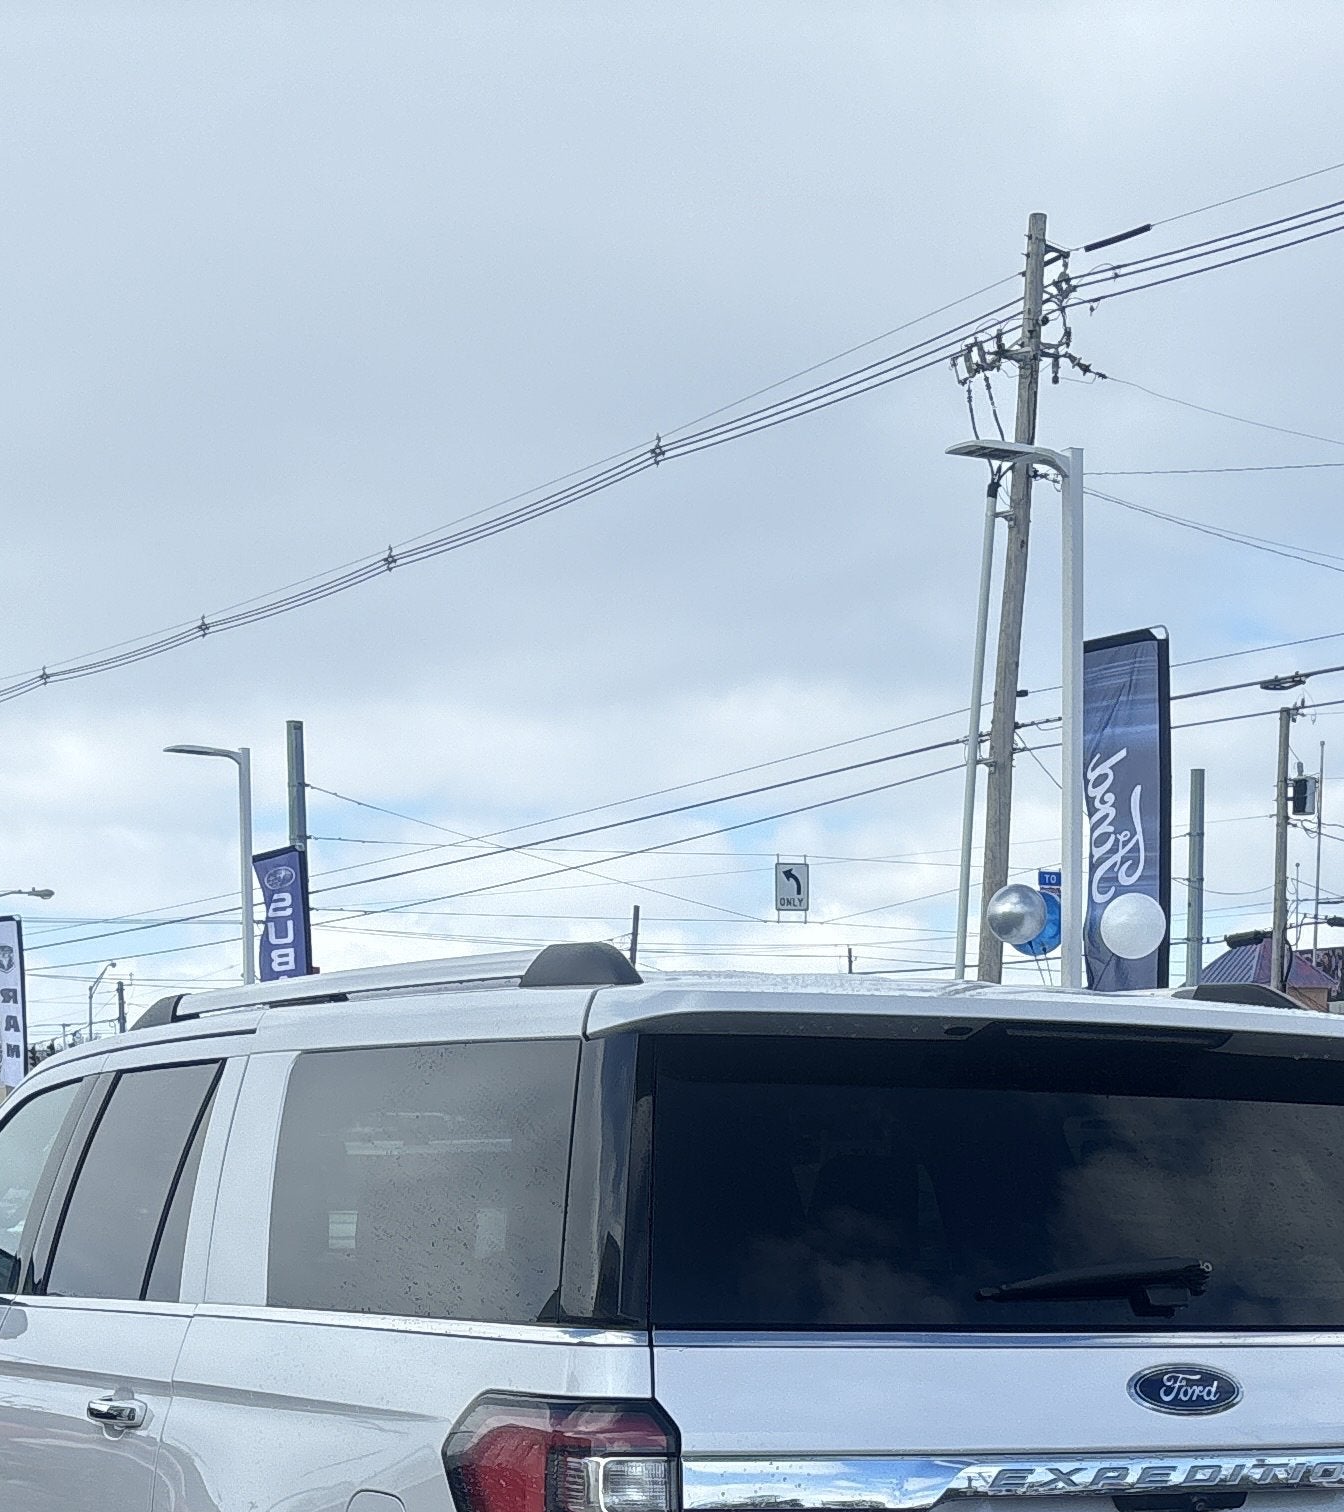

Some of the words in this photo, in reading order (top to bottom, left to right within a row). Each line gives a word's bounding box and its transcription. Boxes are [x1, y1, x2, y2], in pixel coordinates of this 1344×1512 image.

[1044, 874, 1057, 884] TO
[779, 897, 804, 907] ONLY
[1160, 1373, 1220, 1401] Ford
